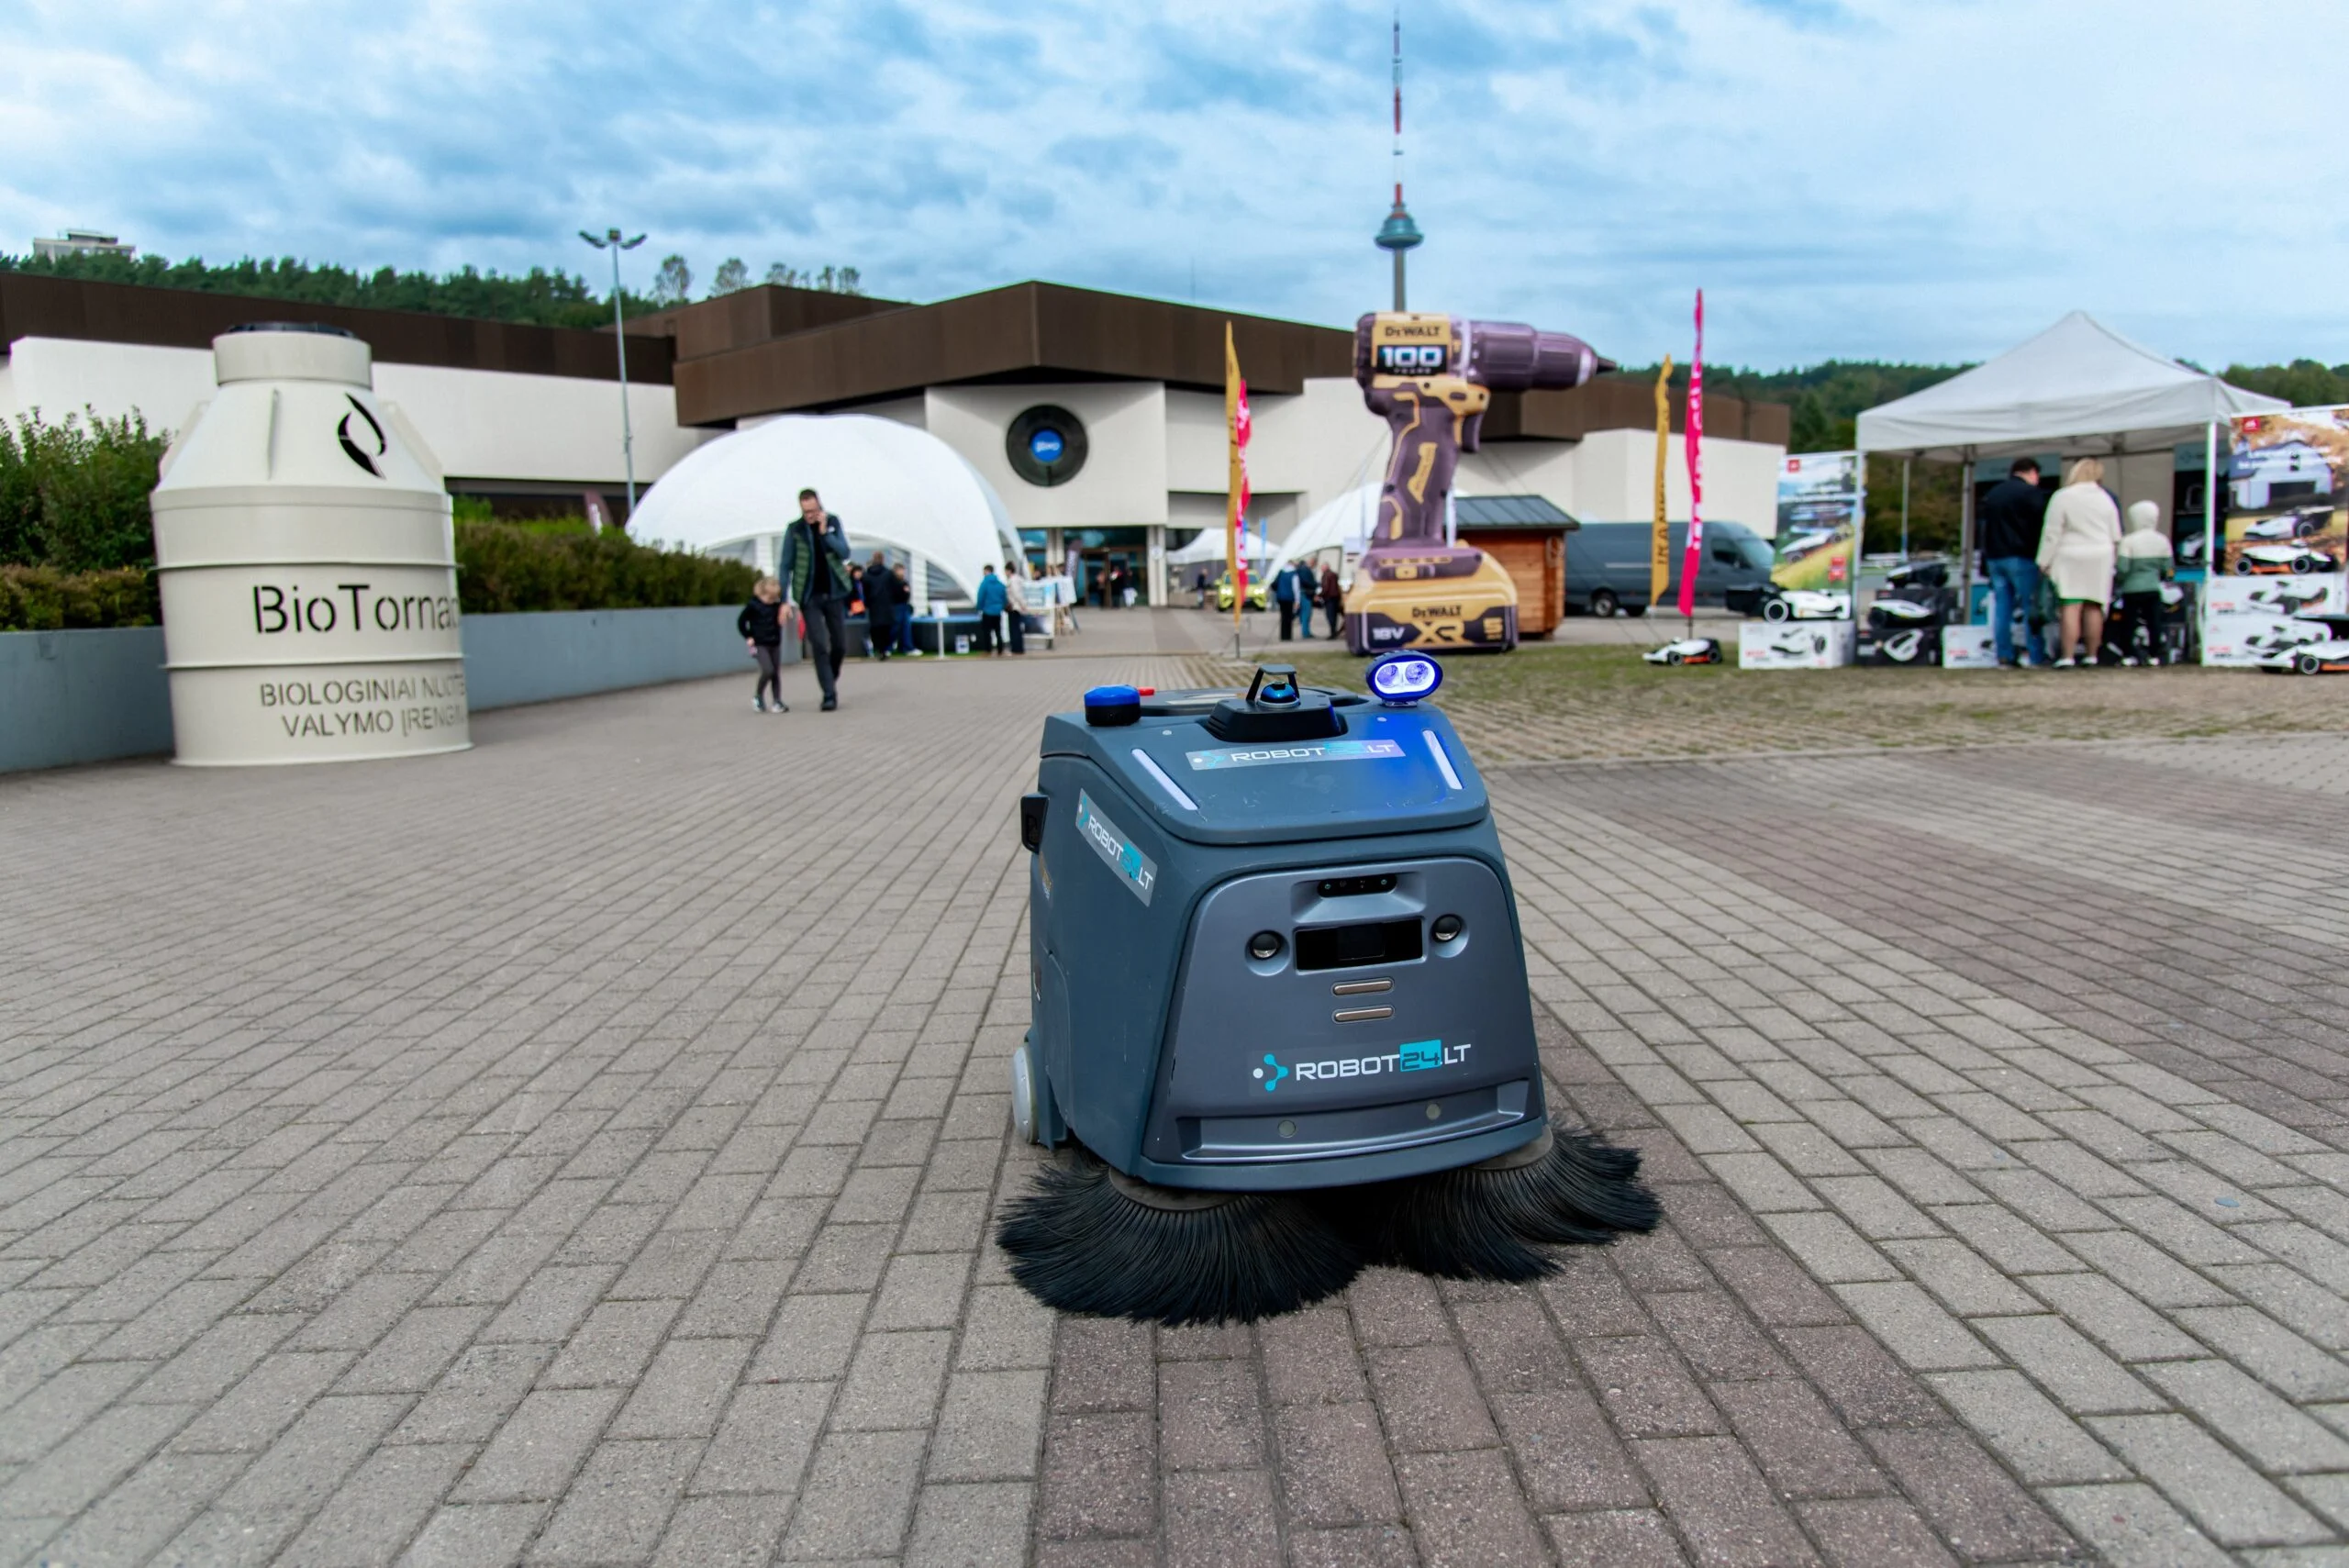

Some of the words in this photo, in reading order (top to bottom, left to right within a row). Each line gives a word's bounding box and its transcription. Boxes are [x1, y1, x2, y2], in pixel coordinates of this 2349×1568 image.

[1381, 346, 1442, 368] 100
[1372, 627, 1406, 640] 18V
[1404, 619, 1475, 648] XR
[261, 675, 417, 706] BIOLOGINIAI
[283, 709, 395, 738] VALYMO
[1296, 1043, 1472, 1081] ROBOT24.LT
